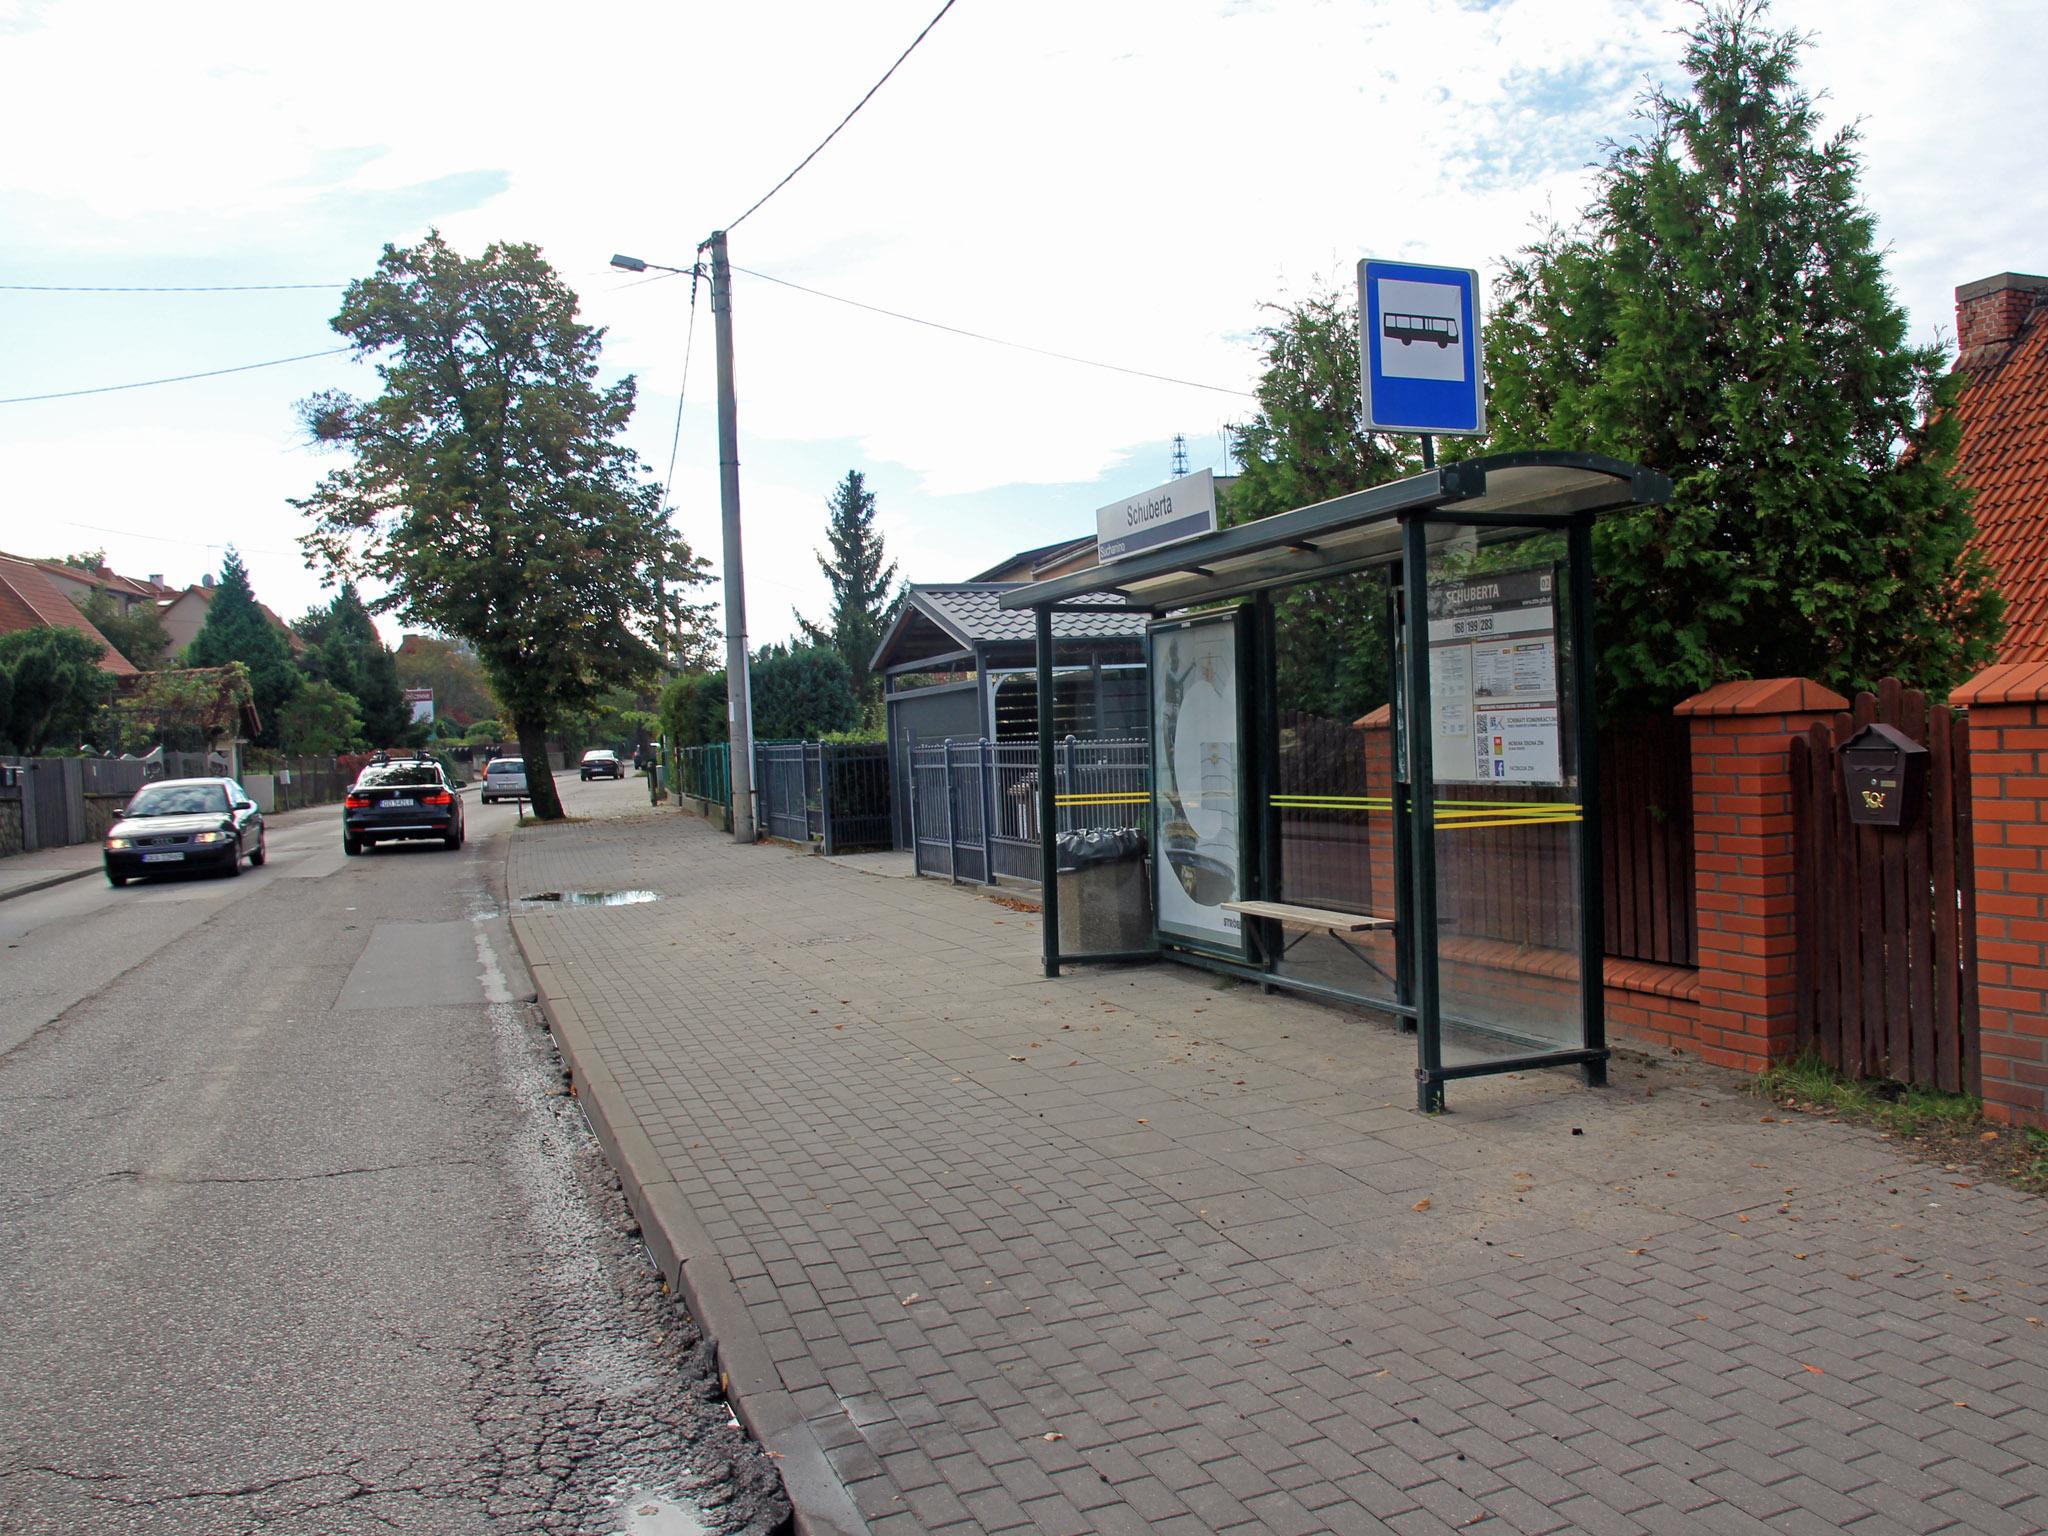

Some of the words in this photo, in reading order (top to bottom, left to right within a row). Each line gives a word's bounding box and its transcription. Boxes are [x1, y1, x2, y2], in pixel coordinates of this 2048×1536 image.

[1127, 495, 1172, 526] Schuberta
[1446, 584, 1500, 603] SCHUBERTA
[1467, 619, 1478, 632] 199
[1480, 618, 1493, 631] 283
